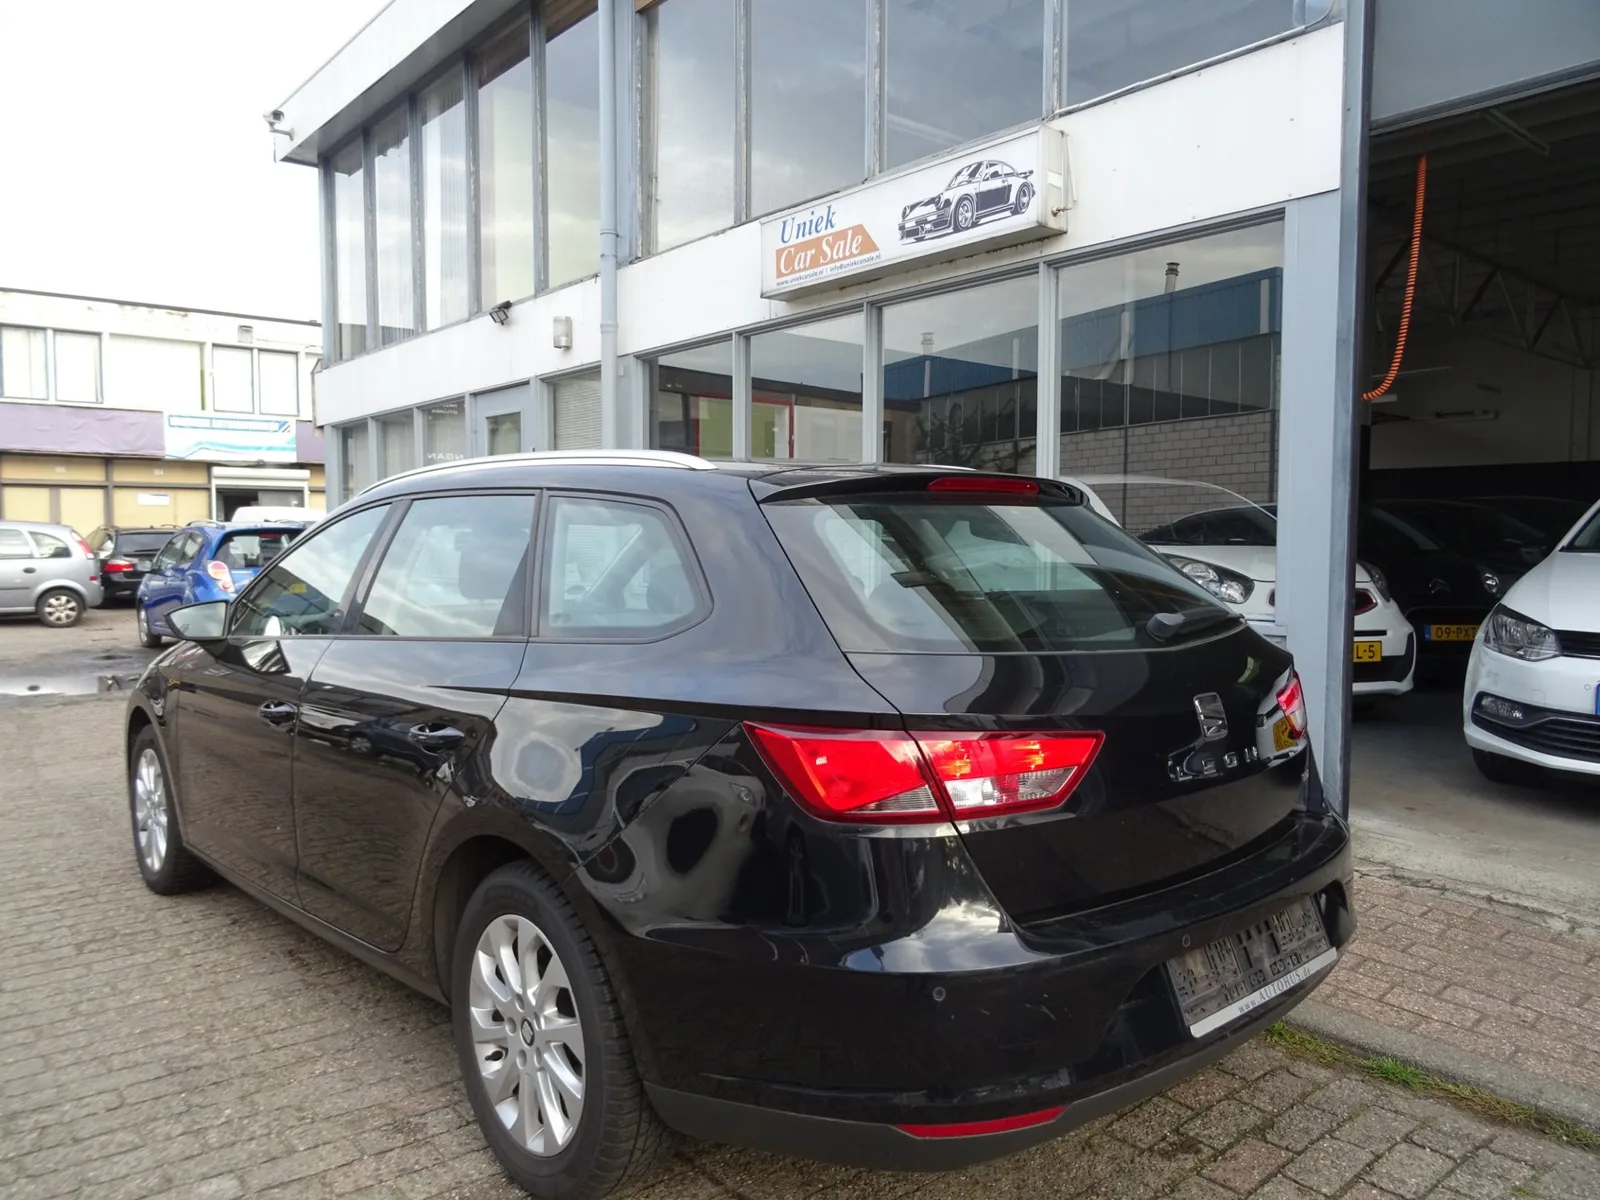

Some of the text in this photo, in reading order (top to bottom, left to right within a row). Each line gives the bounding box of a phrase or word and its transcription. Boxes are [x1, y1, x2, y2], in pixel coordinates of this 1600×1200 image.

[781, 205, 836, 244] Uniek
[780, 229, 863, 274] Car Sale
